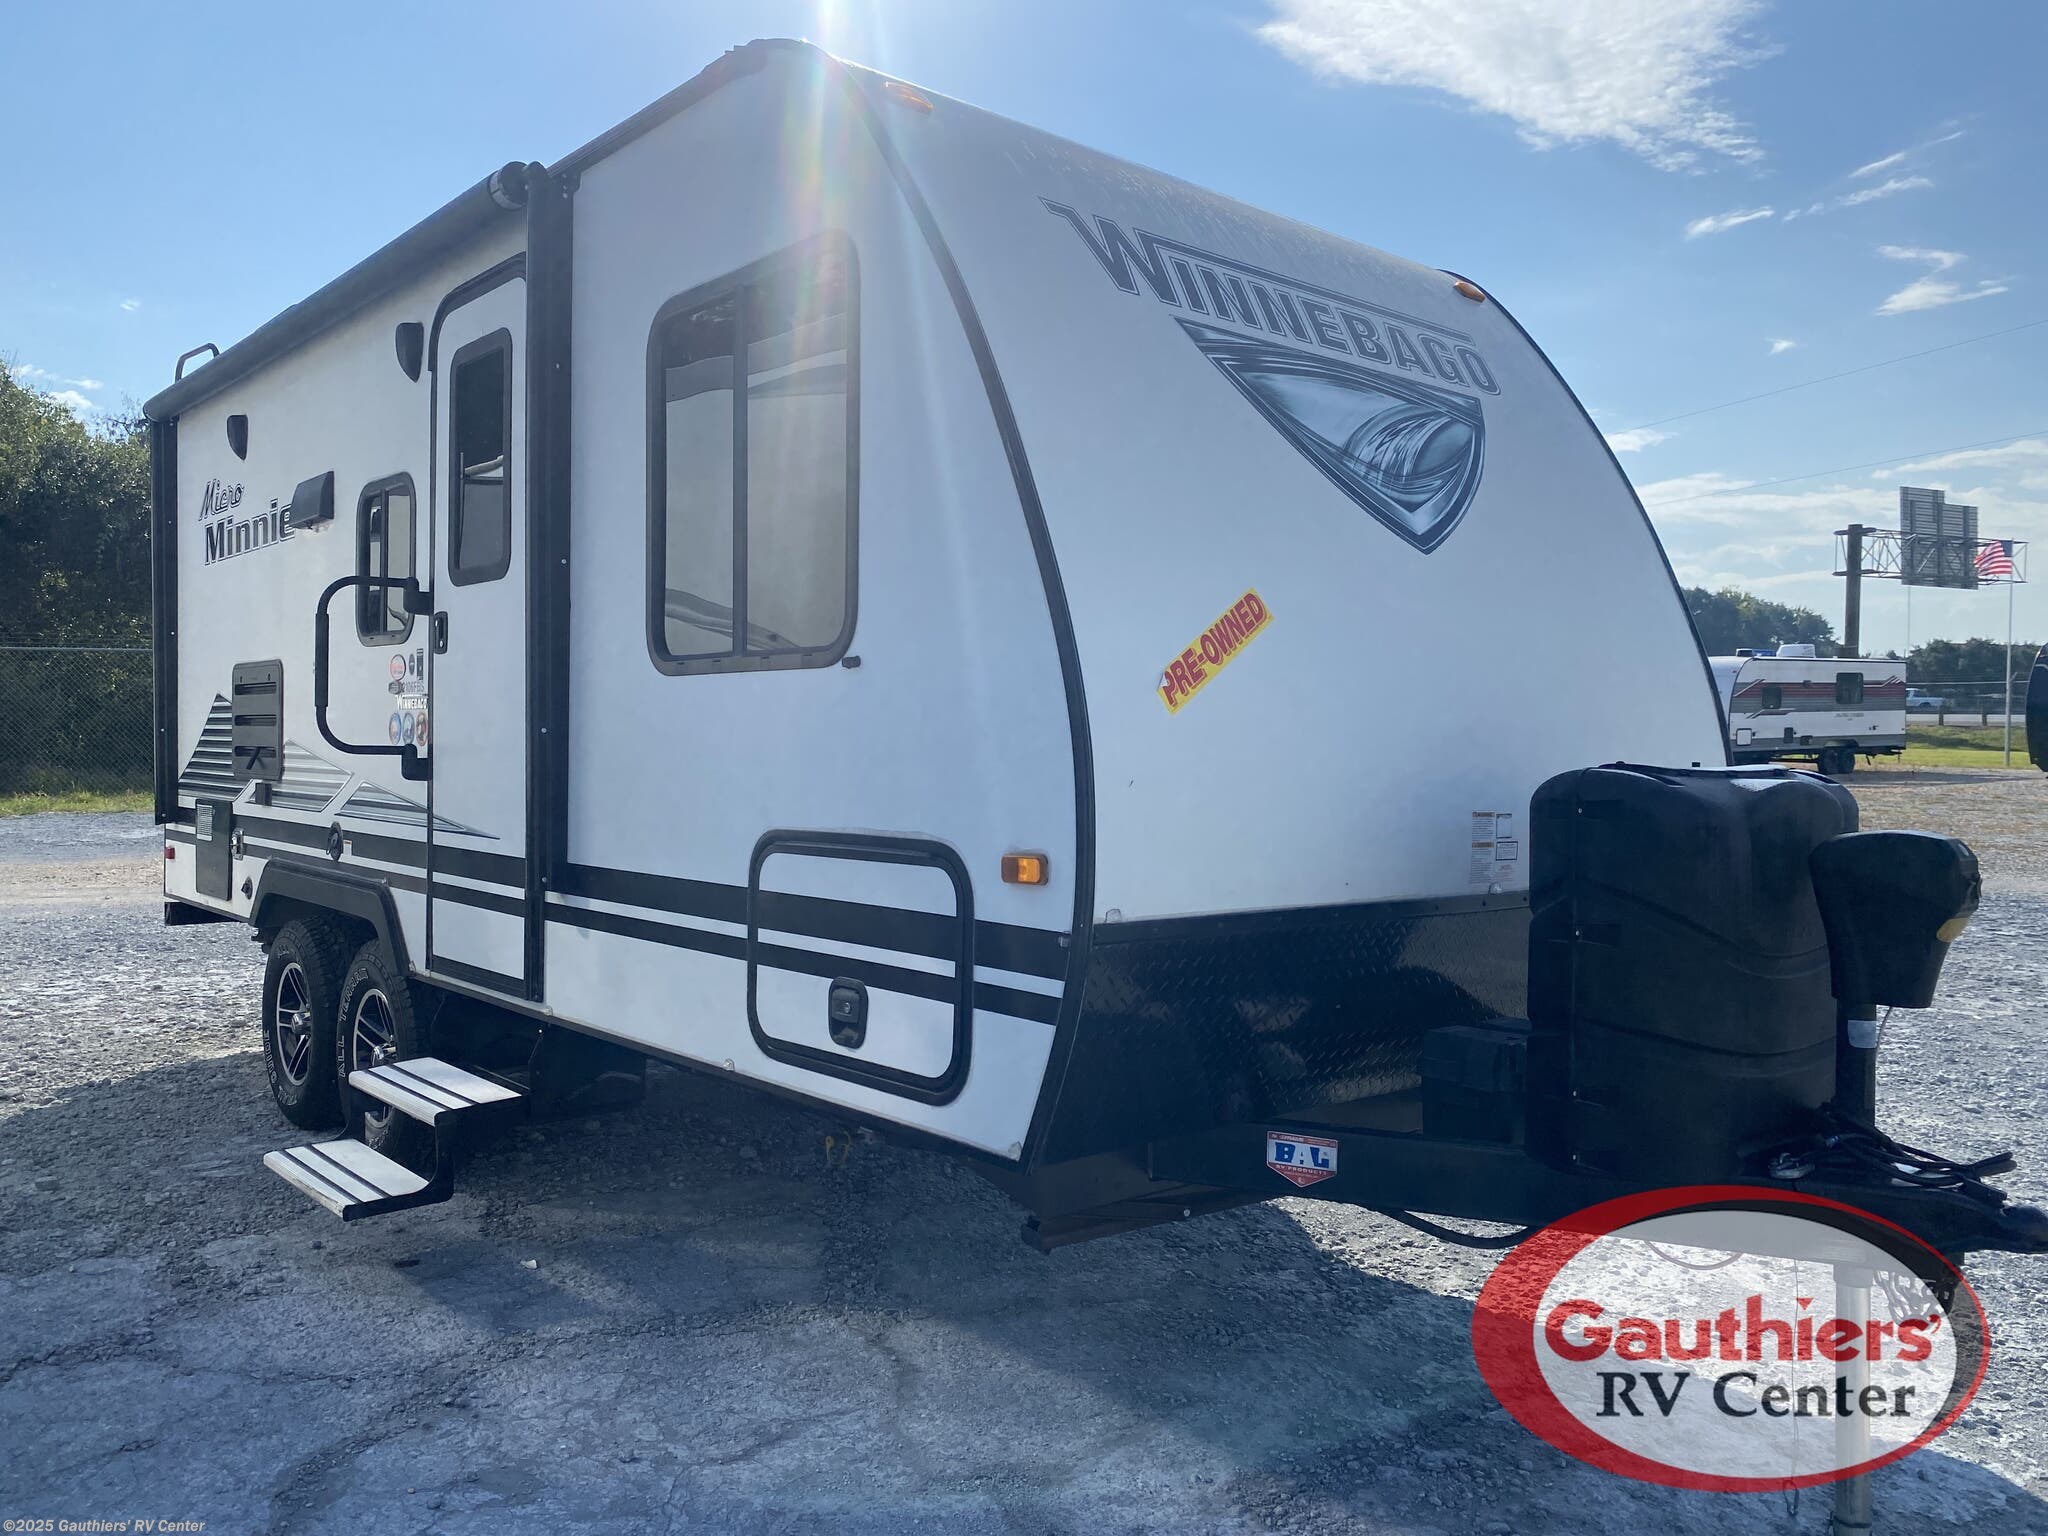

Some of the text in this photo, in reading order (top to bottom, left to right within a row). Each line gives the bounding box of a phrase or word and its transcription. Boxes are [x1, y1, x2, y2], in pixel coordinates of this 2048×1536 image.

[1037, 196, 1501, 396] WINNEBAGO
[198, 479, 245, 521] Micro
[204, 498, 296, 566] Minnie
[1162, 593, 1268, 707] PRE-OWNED
[1274, 1142, 1330, 1169] BAL
